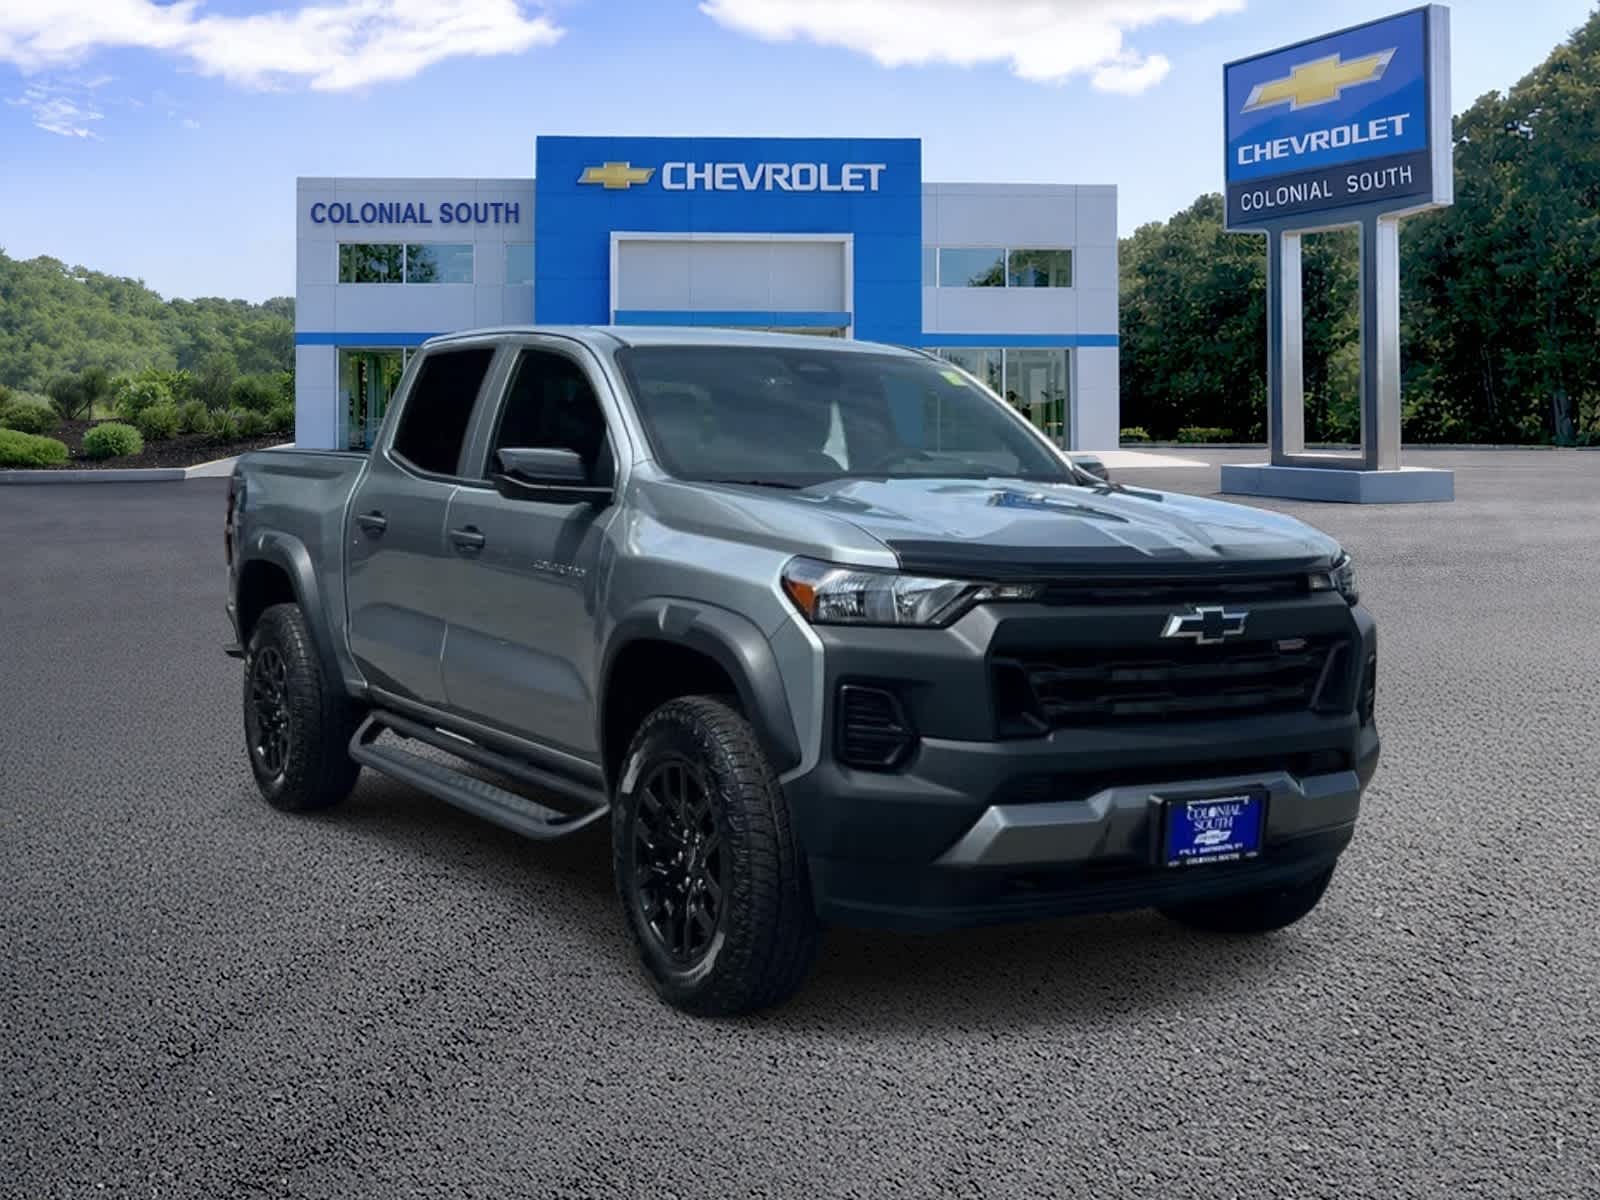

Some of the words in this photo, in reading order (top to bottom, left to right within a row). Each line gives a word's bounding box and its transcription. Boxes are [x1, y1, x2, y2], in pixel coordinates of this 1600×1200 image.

[1237, 113, 1410, 165] CHEVROLET
[662, 162, 886, 191] CHEVROLET
[1240, 180, 1333, 211] COLONIAL
[1346, 165, 1413, 193] SOUTH
[310, 202, 432, 224] COLONIAL
[439, 202, 520, 224] SOUTH
